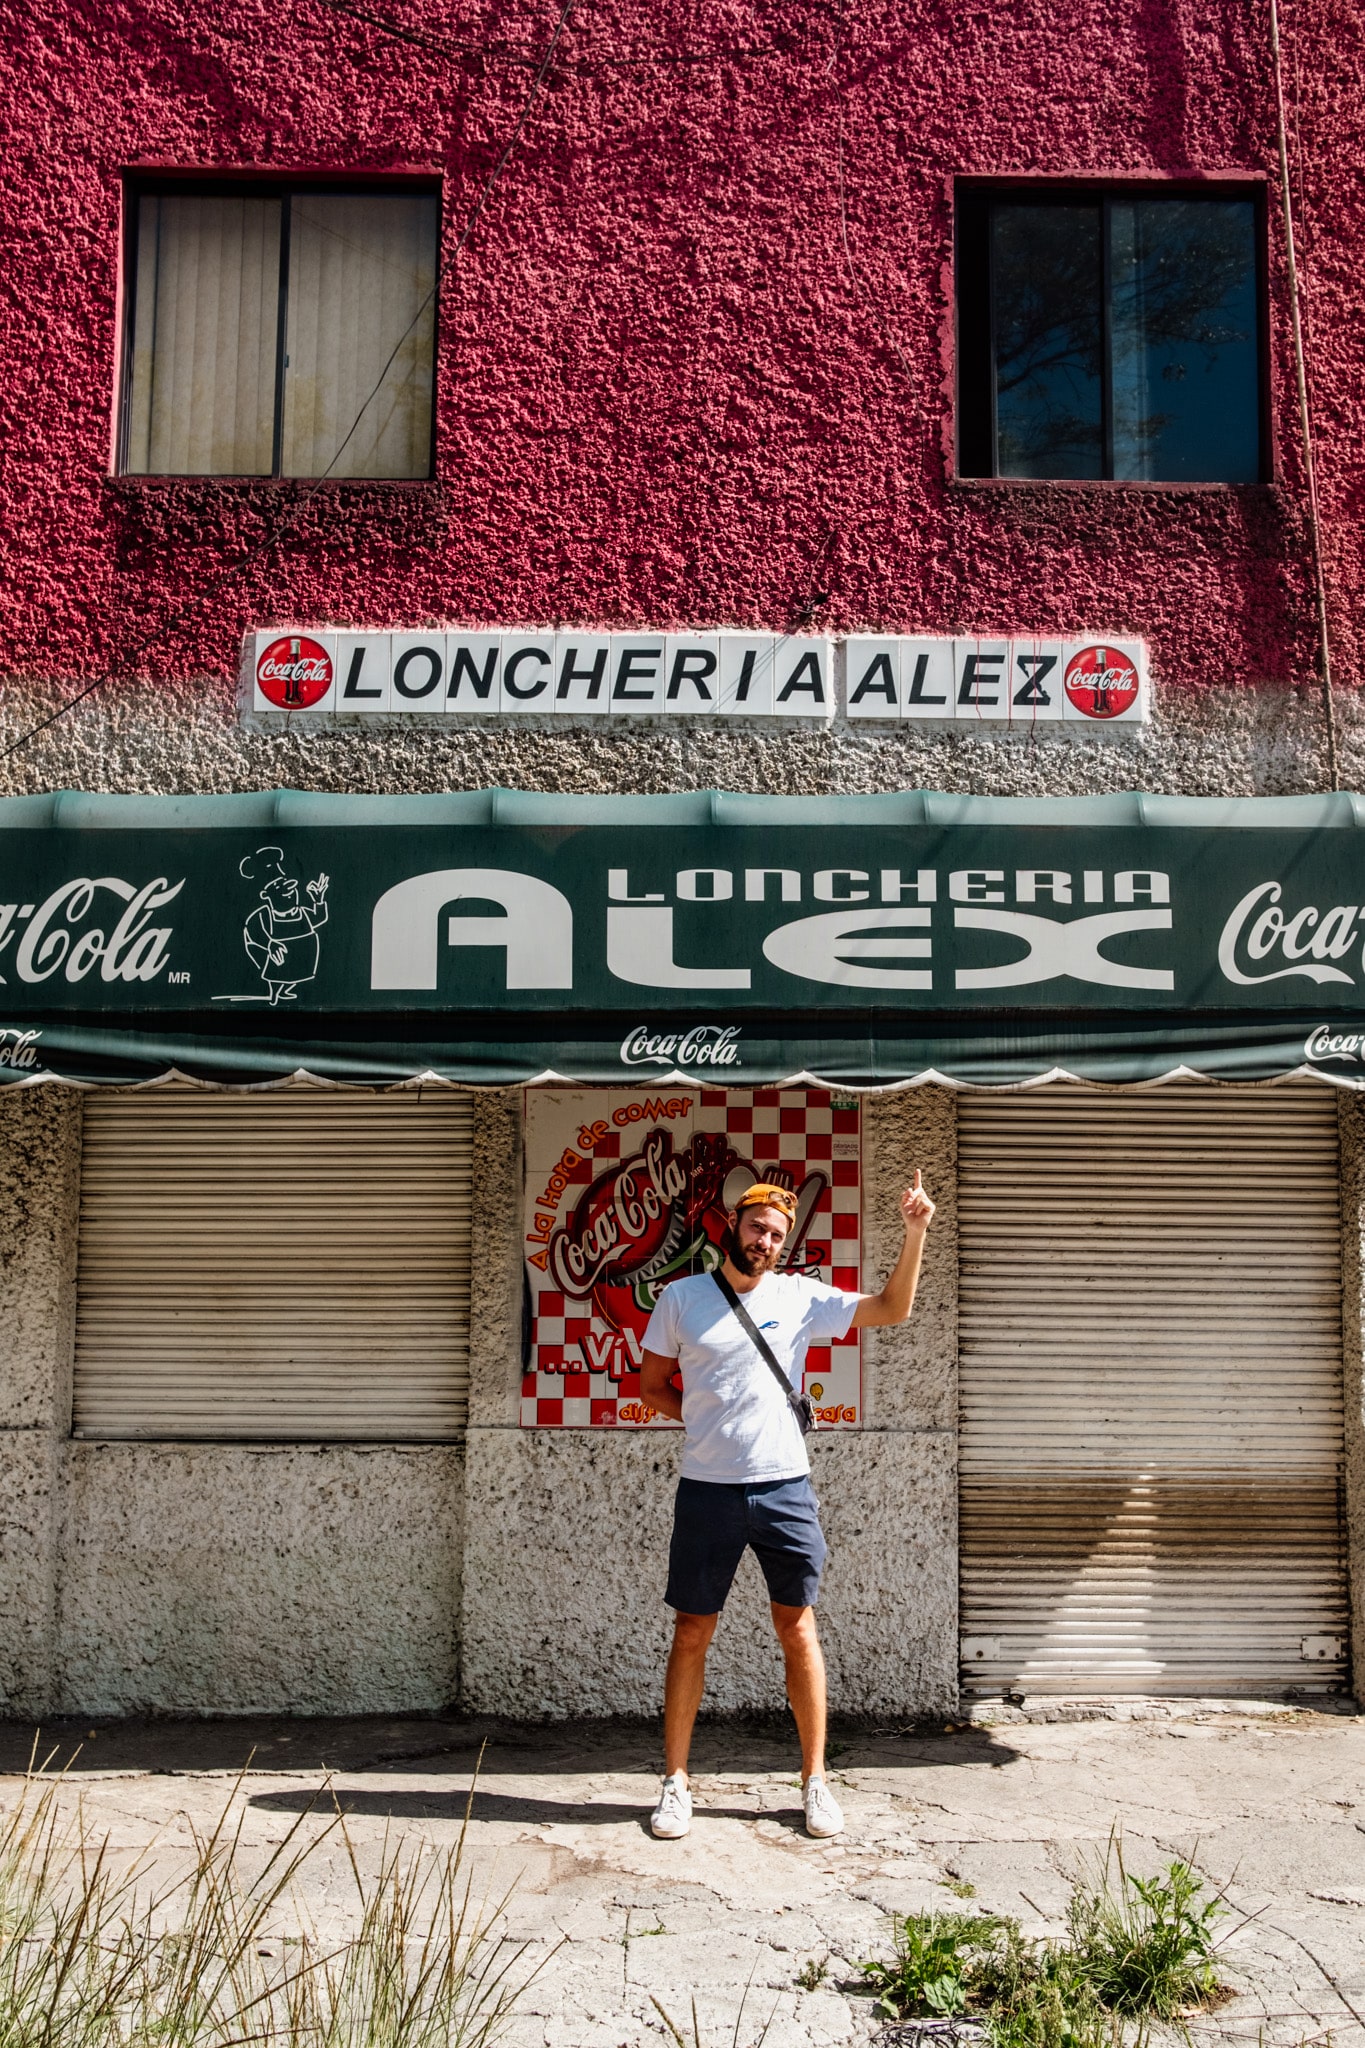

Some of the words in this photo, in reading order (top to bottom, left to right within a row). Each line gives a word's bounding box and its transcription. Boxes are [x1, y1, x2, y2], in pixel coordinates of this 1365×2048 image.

[258, 657, 331, 681] Coca-Cola
[343, 646, 826, 703] LONCHERIA
[1066, 667, 1135, 691] Coca-Cola
[608, 869, 1170, 903] LONCHERIA
[1218, 881, 1365, 985] Coca
[168, 971, 191, 984] MR
[0, 1028, 43, 1068] ola
[620, 1025, 742, 1065] Coca-Cola
[527, 1248, 549, 1272] A
[577, 1120, 609, 1150] de
[554, 1135, 687, 1294] Coca-Cola
